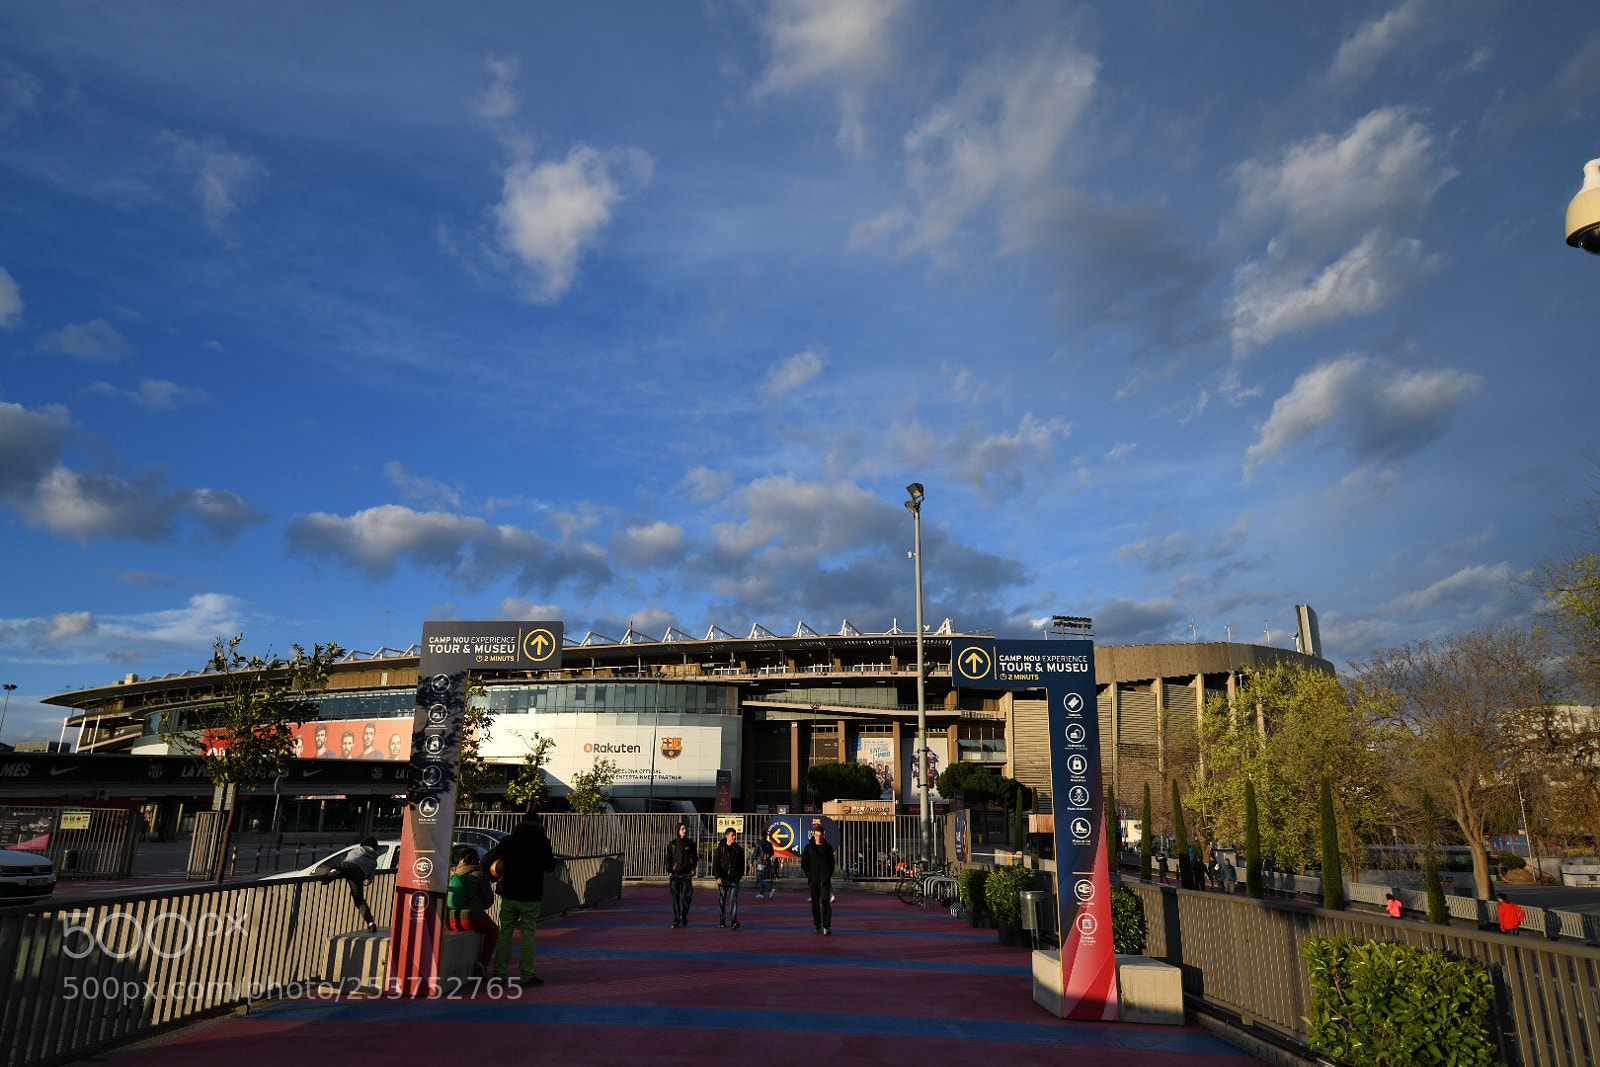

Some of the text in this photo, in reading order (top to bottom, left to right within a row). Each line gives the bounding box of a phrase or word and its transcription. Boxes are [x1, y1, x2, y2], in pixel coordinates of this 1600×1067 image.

[428, 644, 516, 654] TOUR & MUSEU
[1042, 655, 1087, 663] EXPERIENCE
[999, 662, 1089, 673] TOUR & MUSEU
[593, 743, 641, 753] Rakuten
